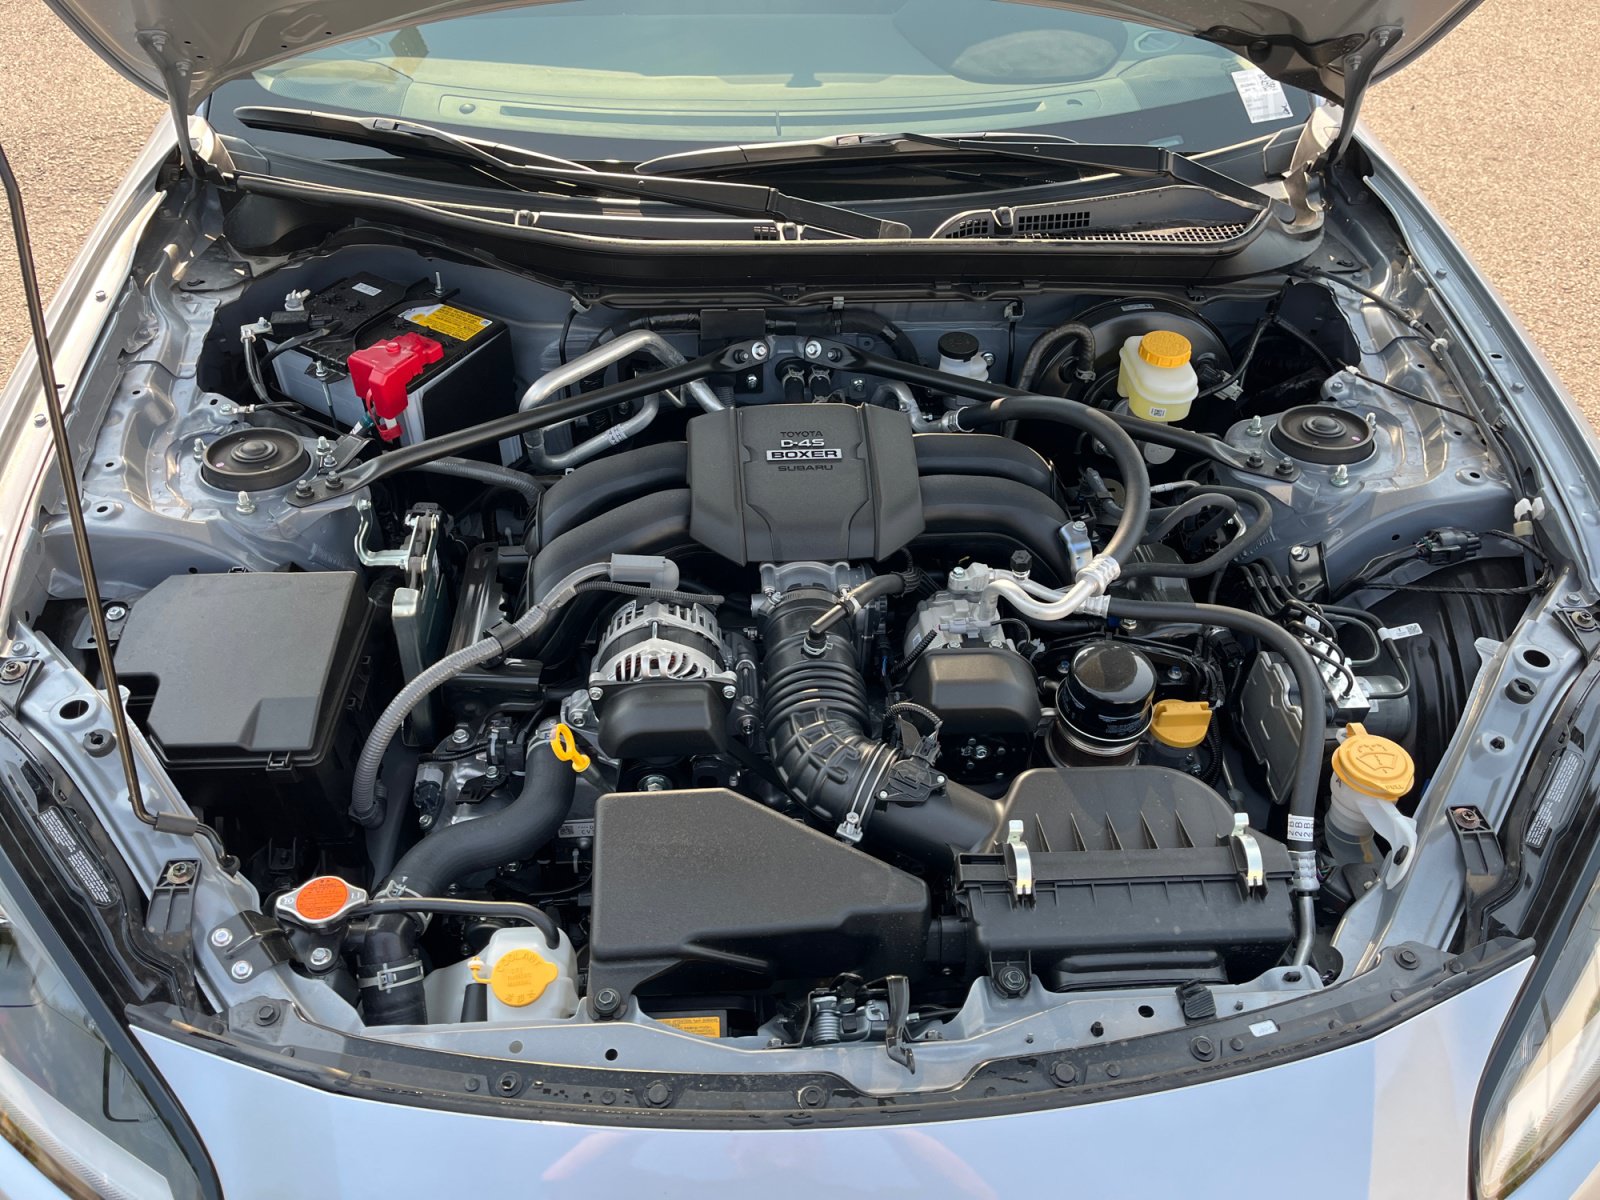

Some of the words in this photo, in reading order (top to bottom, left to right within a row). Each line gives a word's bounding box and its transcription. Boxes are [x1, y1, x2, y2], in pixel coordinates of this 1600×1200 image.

[780, 438, 825, 448] D-4S
[771, 450, 838, 459] BOXER
[778, 464, 834, 472] SUBARU
